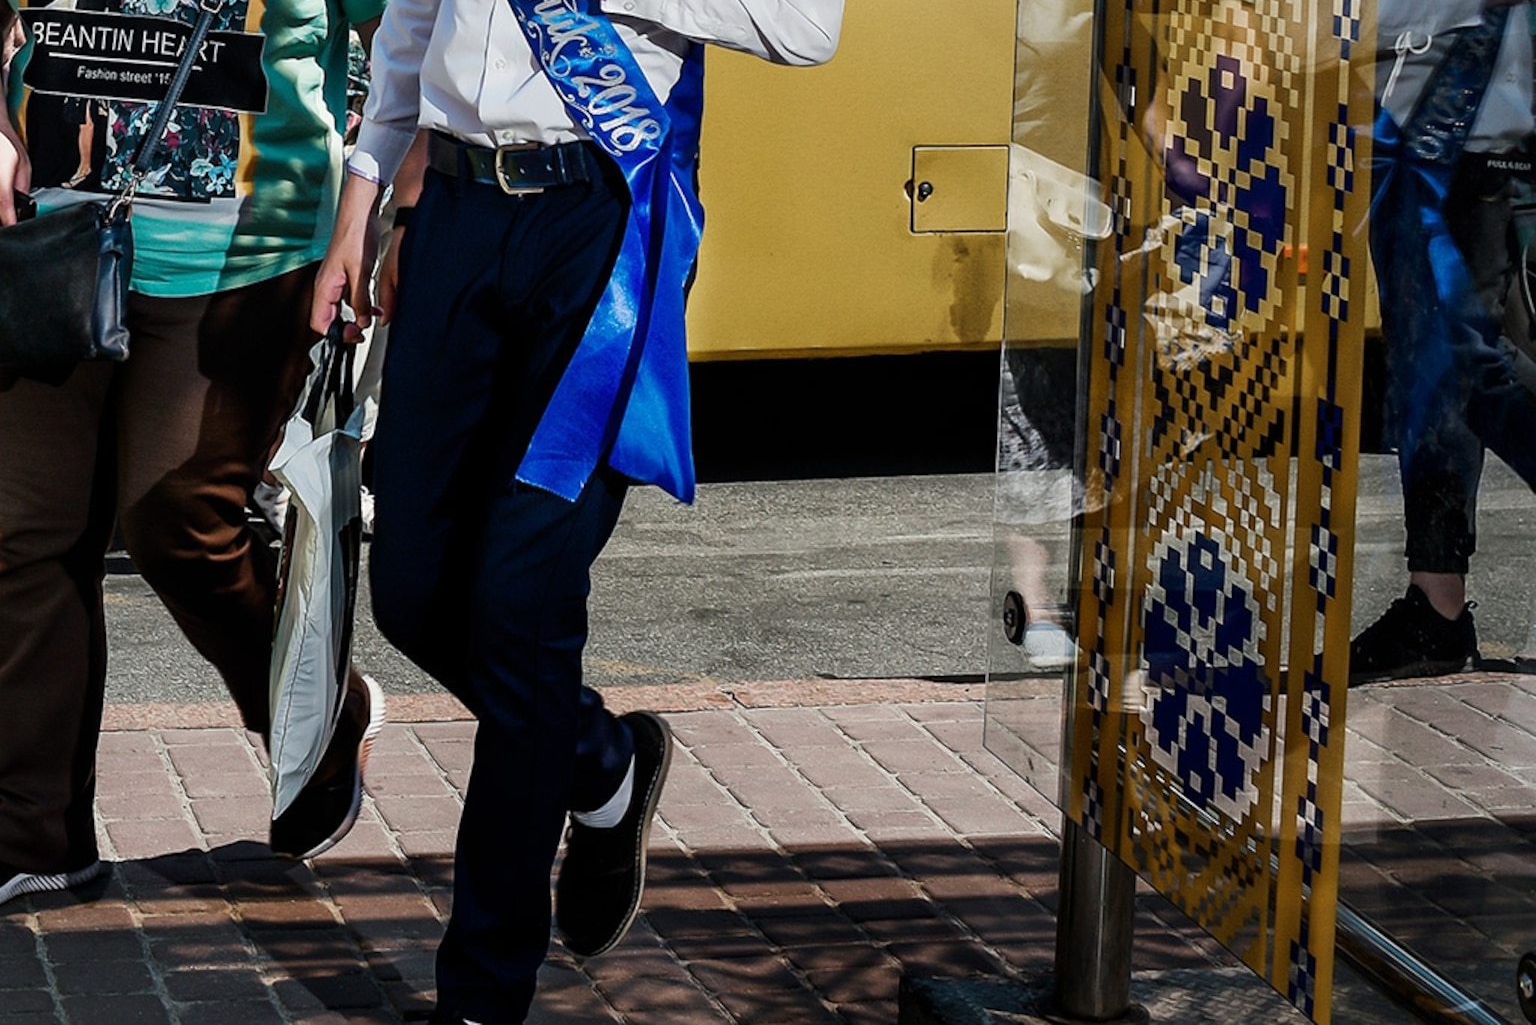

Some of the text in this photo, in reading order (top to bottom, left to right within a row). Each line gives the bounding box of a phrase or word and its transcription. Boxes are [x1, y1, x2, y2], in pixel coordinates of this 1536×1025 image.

[32, 21, 135, 53] BEANTIN
[77, 65, 118, 81] Fashion
[119, 70, 153, 84] street
[571, 63, 662, 152] 2018
